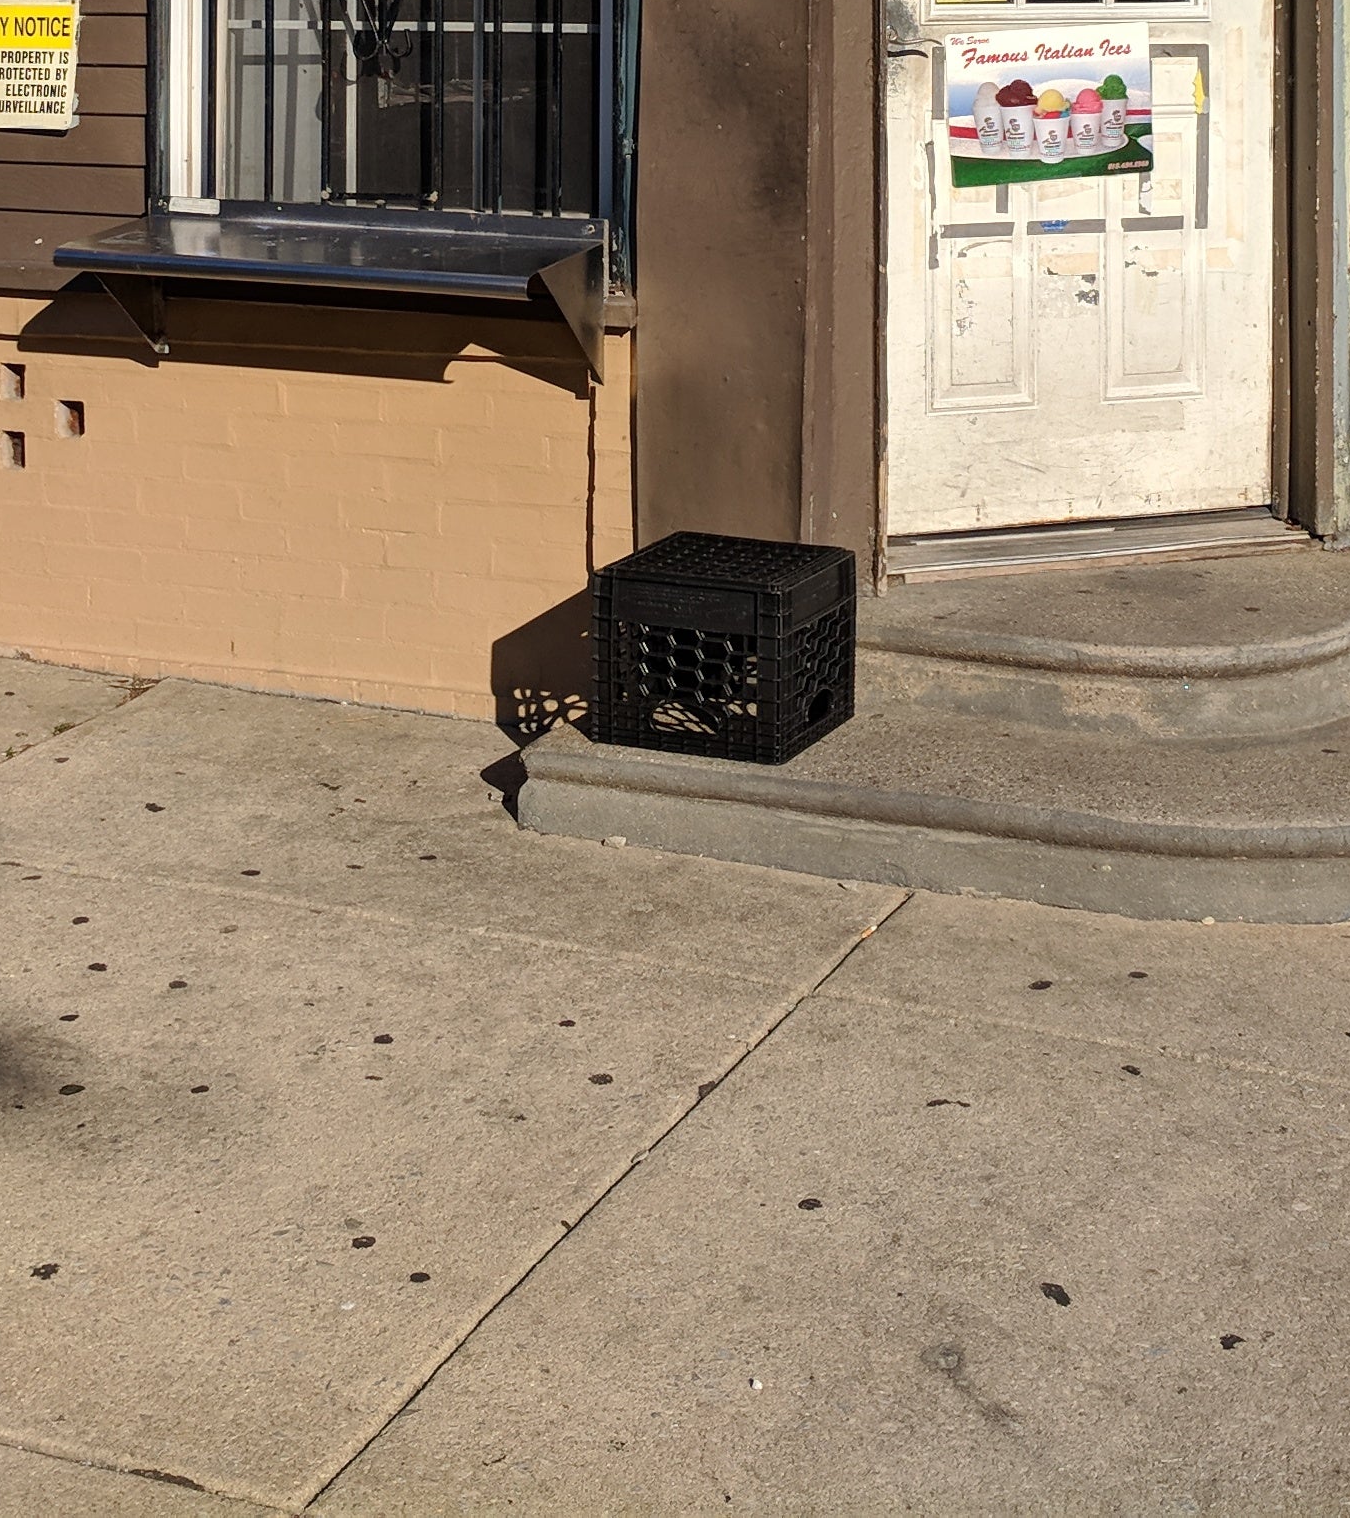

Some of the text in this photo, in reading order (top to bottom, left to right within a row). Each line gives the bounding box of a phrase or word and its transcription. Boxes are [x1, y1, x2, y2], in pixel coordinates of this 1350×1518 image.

[14, 16, 71, 37] NOTICE
[950, 36, 990, 46] We Serve
[1, 51, 54, 64] PROPERTY
[59, 52, 69, 64] IS
[961, 39, 1132, 69] Famous Italian Ices
[55, 68, 68, 81] BY
[5, 84, 68, 97] ELECTRONIC
